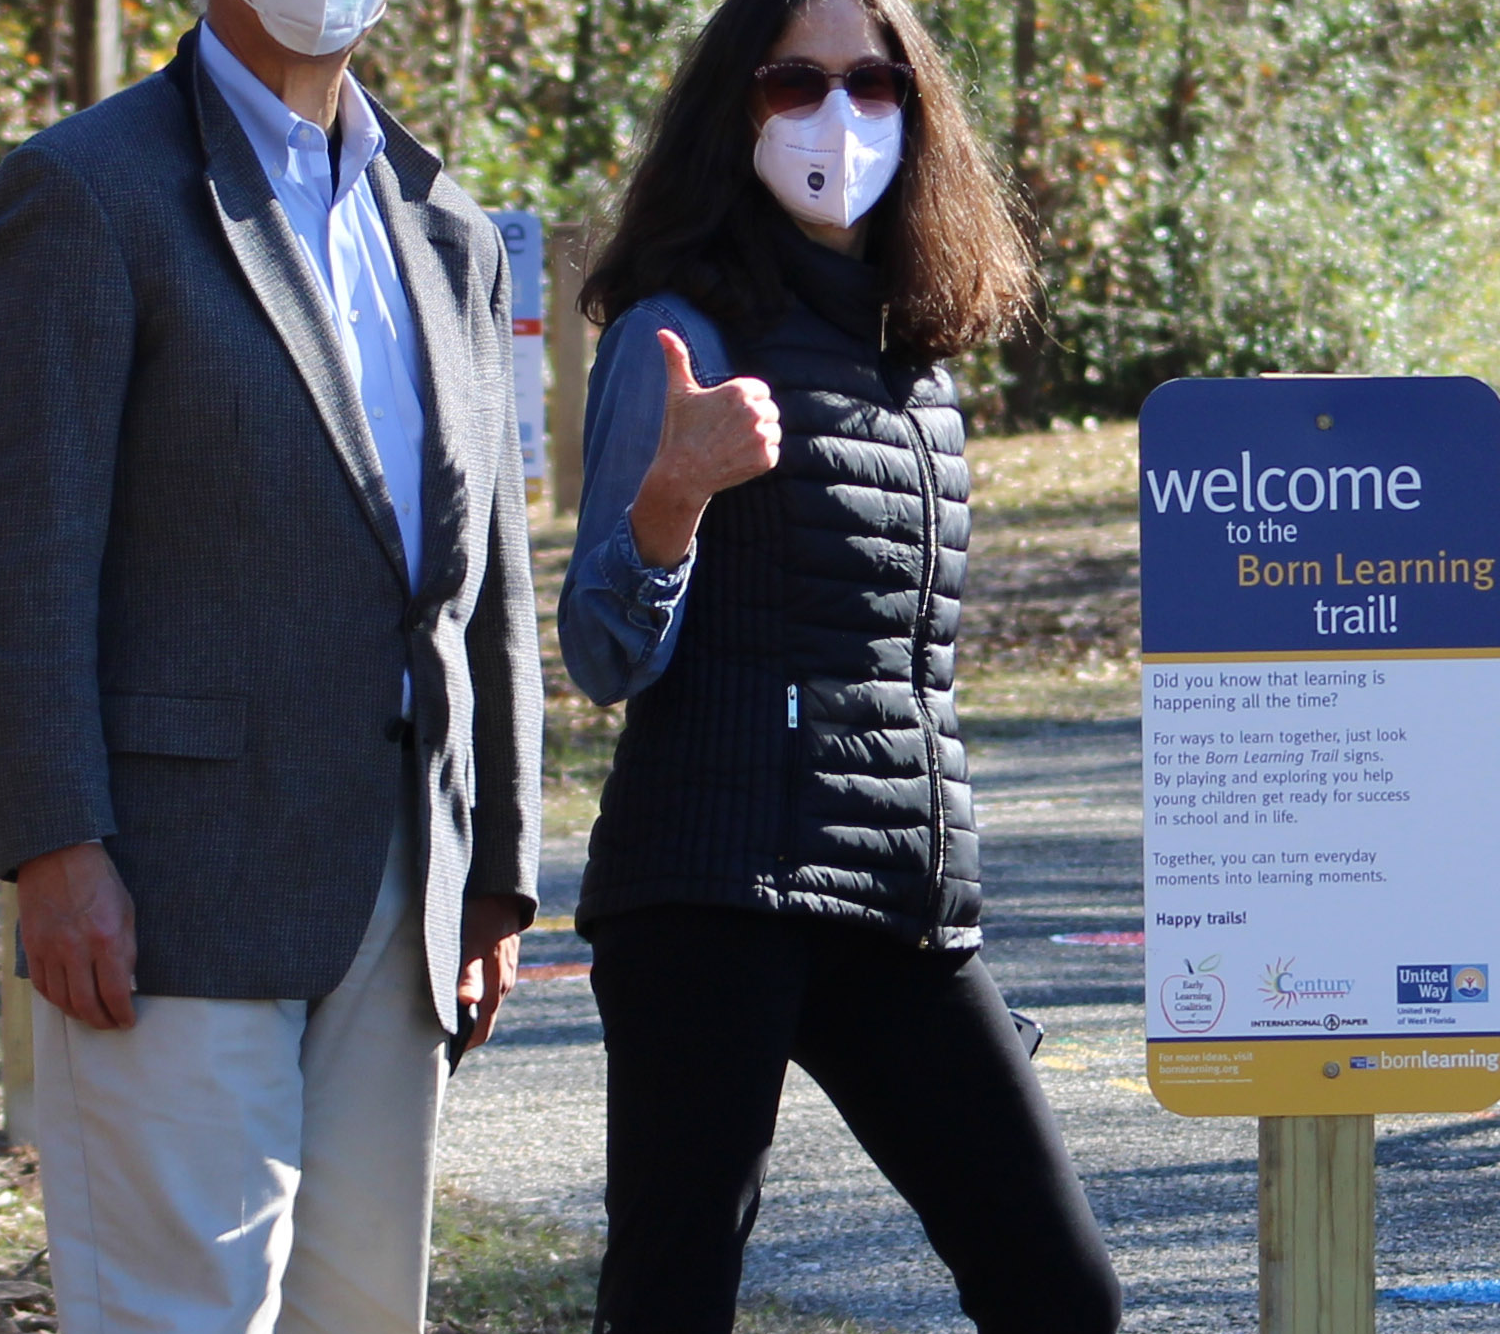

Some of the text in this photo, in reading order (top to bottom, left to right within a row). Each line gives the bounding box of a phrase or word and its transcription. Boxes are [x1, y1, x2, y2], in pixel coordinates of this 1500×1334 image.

[1146, 451, 1422, 513] welcome
[1226, 518, 1298, 544] to the
[1238, 550, 1495, 591] Born Learning
[1313, 595, 1398, 634] trail!
[1154, 669, 1385, 692] Did you know that learning is
[1154, 691, 1338, 714] happening all the time?
[1154, 727, 1407, 748] For ways to learn together, just look
[1154, 748, 1383, 767] for the Born Learning Trail signs.
[1154, 767, 1393, 789] By playing and exploring you help
[1153, 788, 1410, 809] young children get ready for success
[1155, 809, 1297, 826] in school and in life.
[1153, 848, 1377, 869] Together, you can turn everyday
[1156, 869, 1387, 887] moments into learning moments.
[1157, 910, 1246, 929] Happy trails!
[1182, 980, 1204, 990] Early
[1275, 972, 1355, 995] Century
[1399, 968, 1448, 983] United
[1175, 992, 1212, 1002] Learning
[1419, 984, 1448, 1001] Way
[1174, 1002, 1212, 1011] Coalition
[1424, 1007, 1441, 1015] Way
[1251, 1018, 1368, 1027] INTERNATIONAL PAPER
[1381, 1049, 1500, 1072] bornlearning
